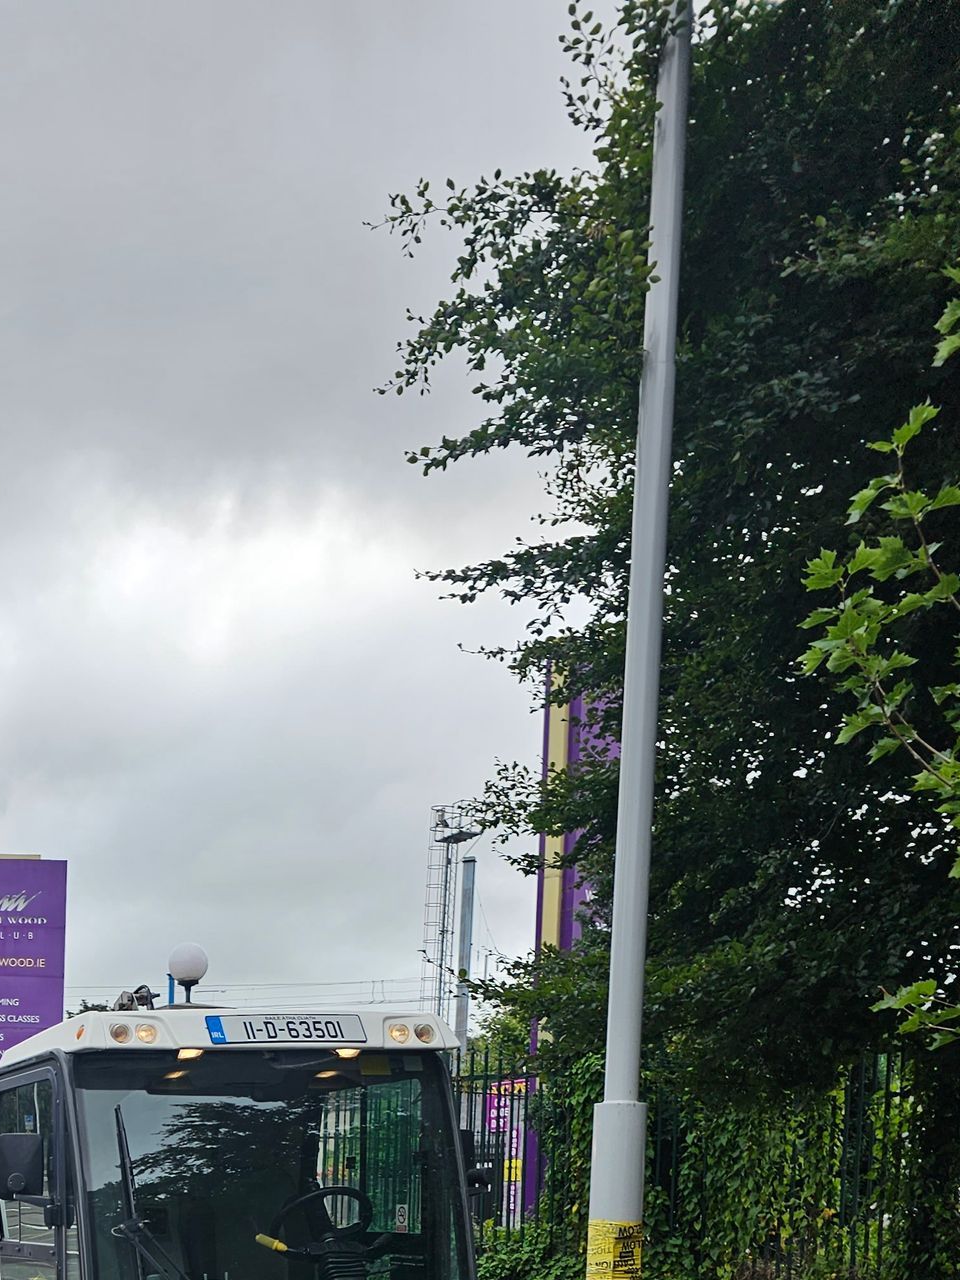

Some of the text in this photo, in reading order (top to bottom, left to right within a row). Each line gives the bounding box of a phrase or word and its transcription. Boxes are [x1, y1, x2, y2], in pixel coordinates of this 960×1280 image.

[7, 916, 47, 925] WOOD
[7, 1014, 40, 1023] CLASSES
[242, 1020, 345, 1040] 11-D-63501
